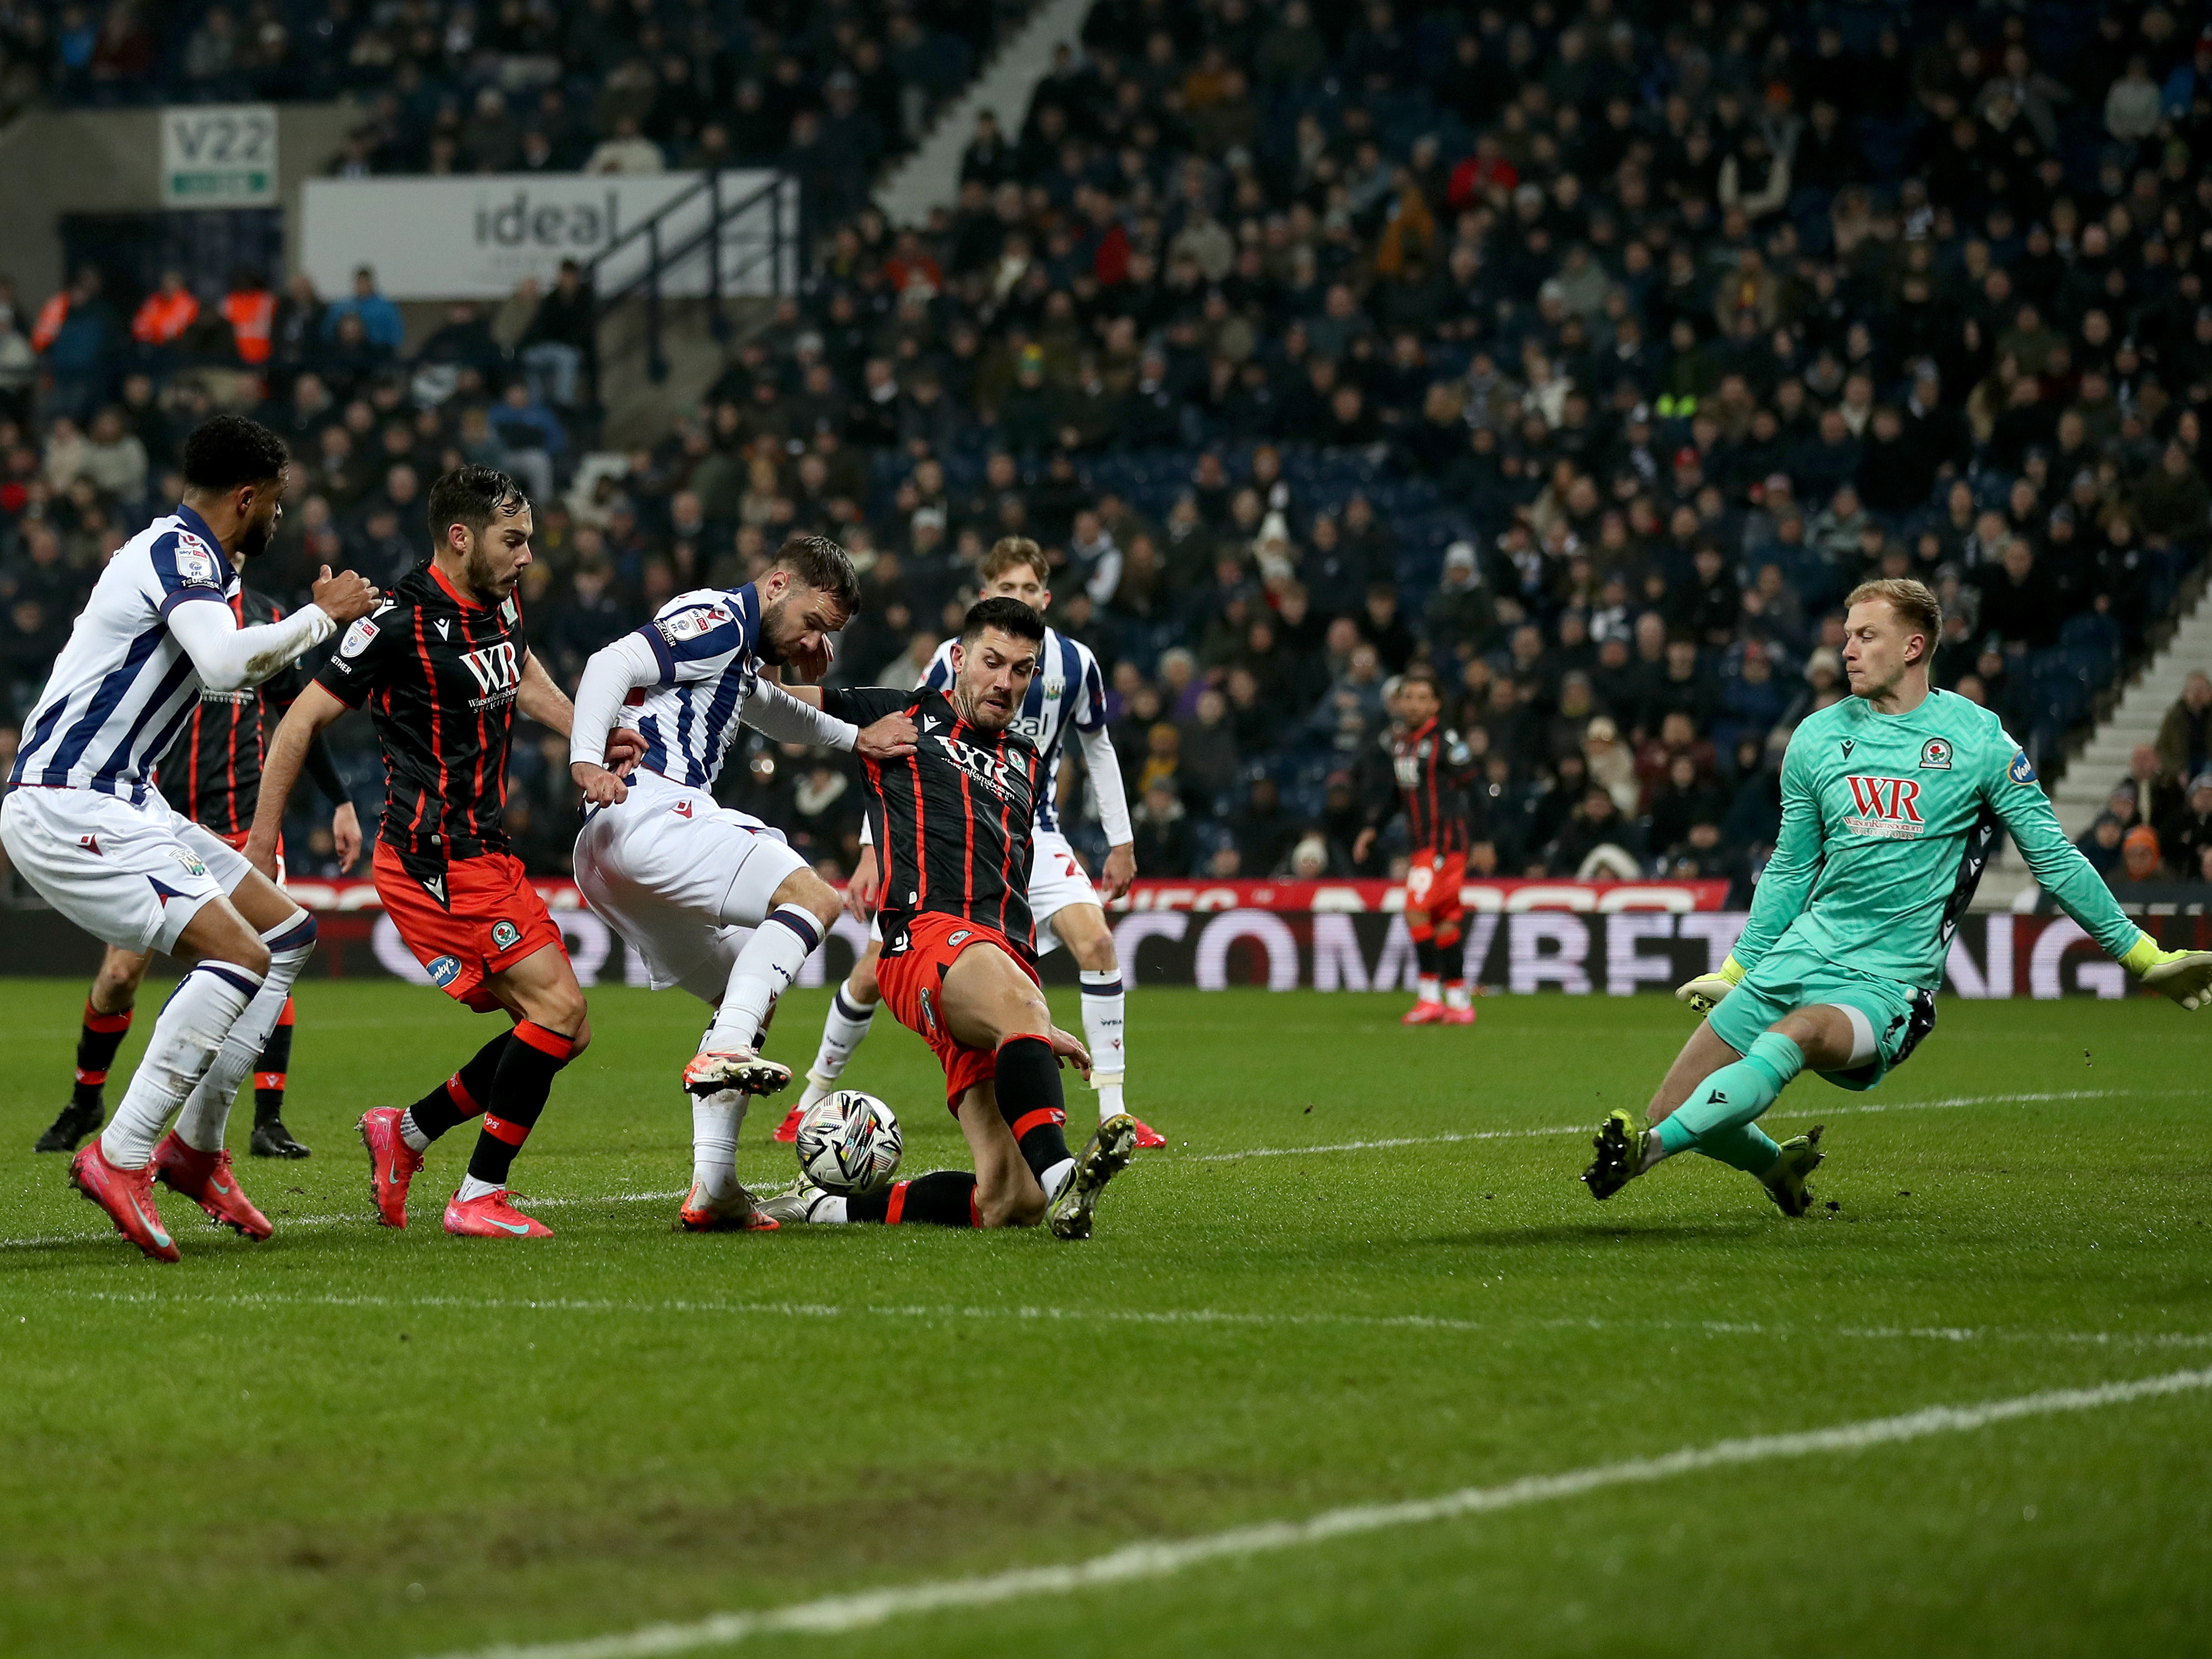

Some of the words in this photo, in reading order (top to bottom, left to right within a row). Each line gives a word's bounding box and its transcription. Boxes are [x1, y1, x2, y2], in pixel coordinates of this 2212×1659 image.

[173, 117, 270, 160] V22
[474, 186, 619, 246] ideal
[670, 623, 678, 634] EFL
[458, 641, 521, 694] WR
[473, 696, 514, 713] SOLICITOR
[934, 734, 1016, 794] WR
[1845, 776, 1925, 823] WR
[1850, 827, 1915, 840] SOLICITORS
